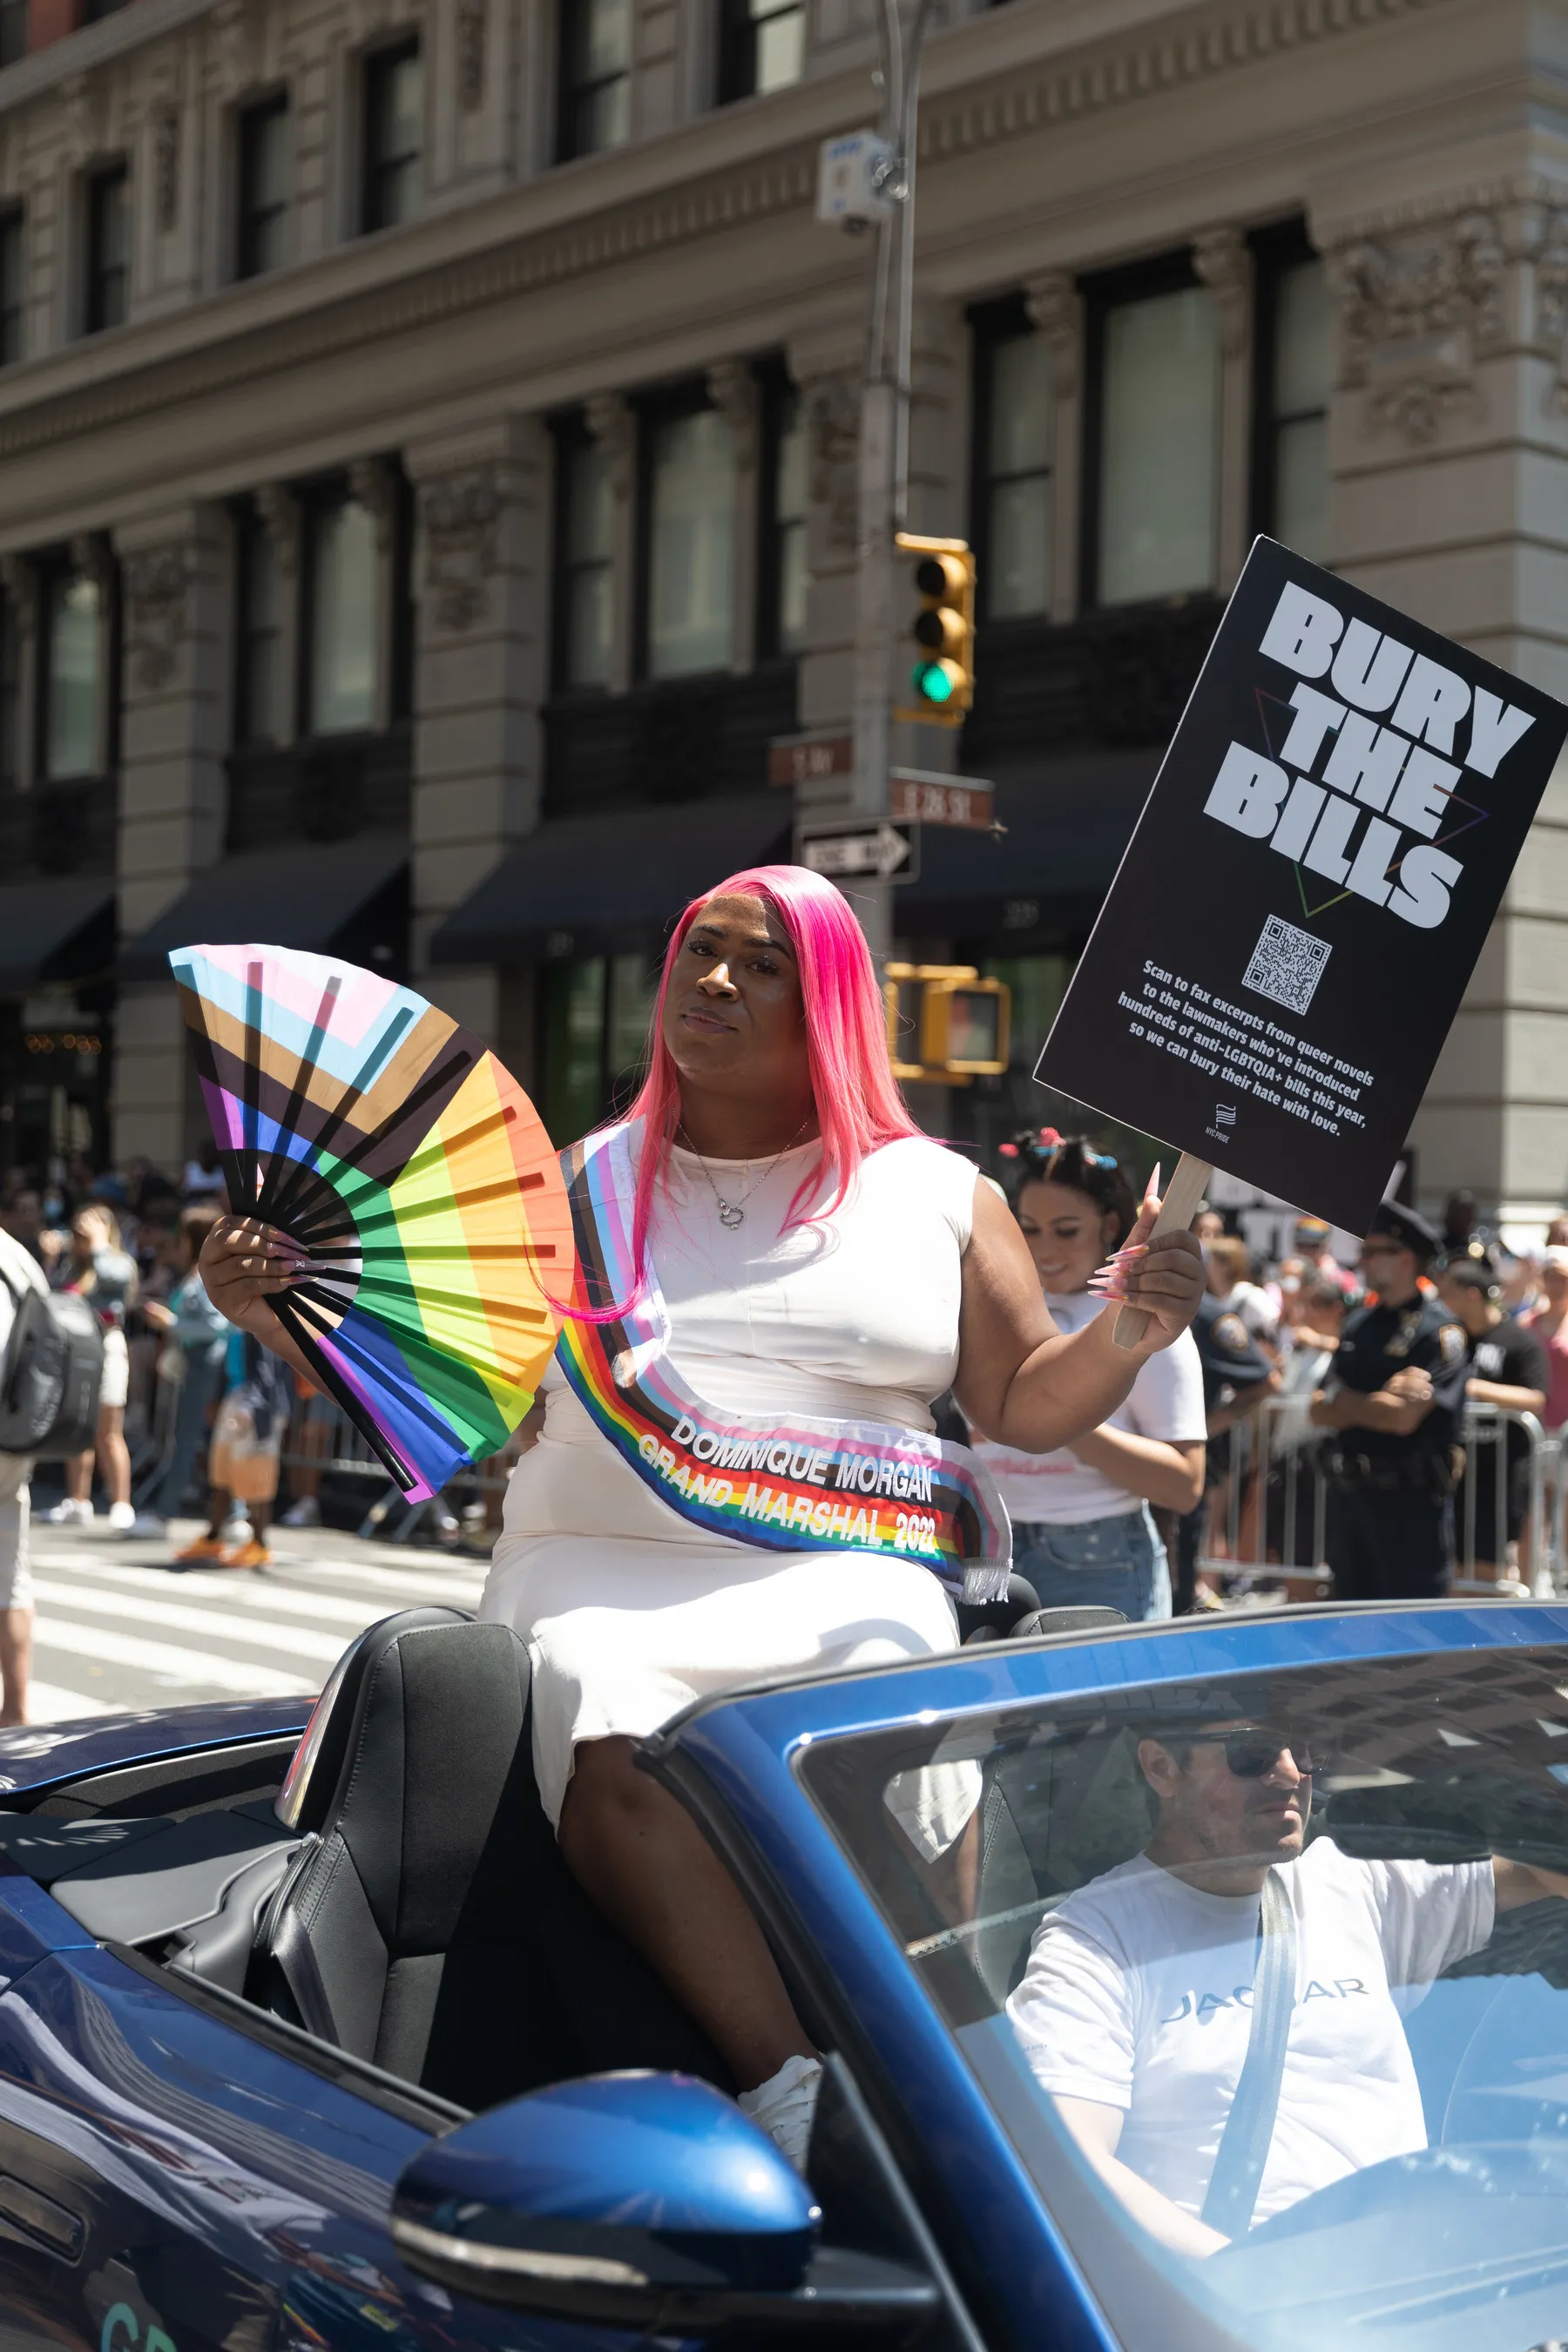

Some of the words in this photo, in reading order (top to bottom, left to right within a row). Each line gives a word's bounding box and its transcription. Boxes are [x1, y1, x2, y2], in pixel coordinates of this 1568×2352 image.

[1259, 581, 1537, 779] BURY
[1280, 682, 1463, 839] THE
[1203, 741, 1463, 928] BILLS
[1118, 991, 1177, 1031] hundreds
[1179, 1025, 1194, 1038] of
[1193, 1032, 1282, 1081] anti-LGBTQIA+
[1284, 1075, 1311, 1098] bills
[1312, 1091, 1335, 1110] this
[1335, 1105, 1365, 1128] year,
[1129, 1023, 1144, 1036] so
[1146, 1031, 1164, 1046] we
[1166, 1042, 1188, 1058] can
[1190, 1050, 1220, 1075] bury
[1221, 1067, 1252, 1090] their
[1253, 1081, 1281, 1105] hate
[1283, 1099, 1309, 1119] with
[1311, 1111, 1340, 1136] love.
[1143, 960, 1173, 983] Scan
[1174, 977, 1188, 991] to
[1190, 983, 1211, 1004] fax
[1213, 998, 1264, 1031] excerpts
[1266, 1022, 1295, 1046] from
[1297, 1041, 1333, 1064] queer
[1334, 1059, 1374, 1085] novels
[1143, 983, 1157, 997] to
[1159, 991, 1180, 1010] the
[1182, 1002, 1247, 1044] lawmakers
[1294, 1058, 1360, 1101] introduced
[1205, 1126, 1216, 1137] NYC
[1215, 1131, 1230, 1144] PRIDE
[639, 1434, 733, 1508] GRAND
[740, 1483, 883, 1546] MARSHAL
[894, 1511, 936, 1554] 2022
[671, 1416, 834, 1484] DOMINIQUE
[835, 1452, 932, 1503] MORGAN
